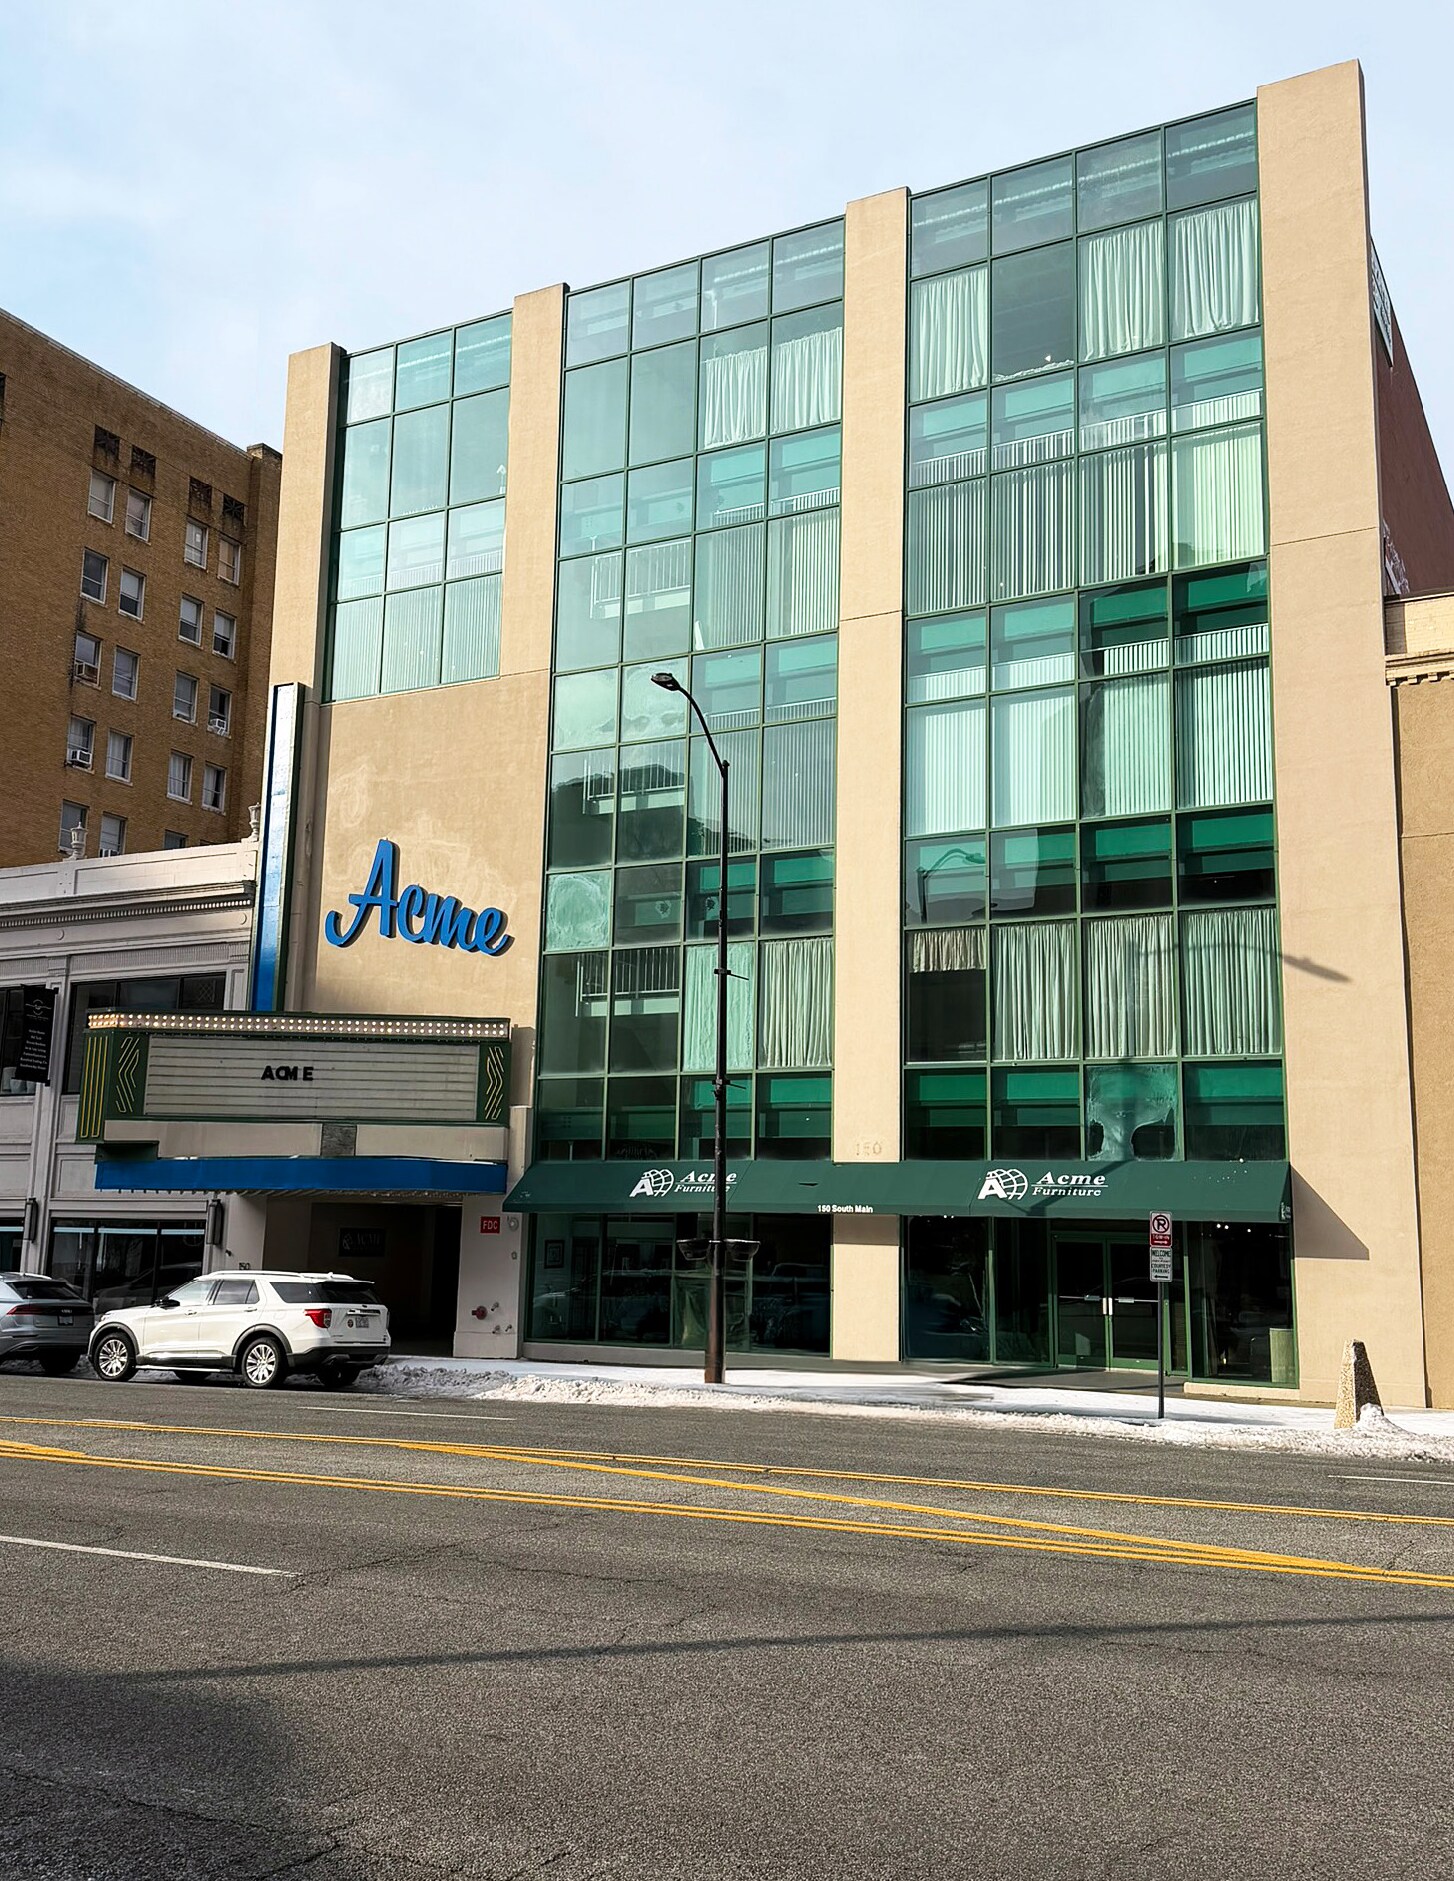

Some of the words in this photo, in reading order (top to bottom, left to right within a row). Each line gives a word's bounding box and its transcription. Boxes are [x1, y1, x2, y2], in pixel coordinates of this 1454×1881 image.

[325, 838, 514, 956] Acme
[1036, 1171, 1106, 1185] Acme
[1032, 1187, 1102, 1196] Furniture
[817, 1204, 831, 1213] 150
[831, 1204, 854, 1213] South
[854, 1204, 874, 1214] Main
[482, 1220, 498, 1230] FDC
